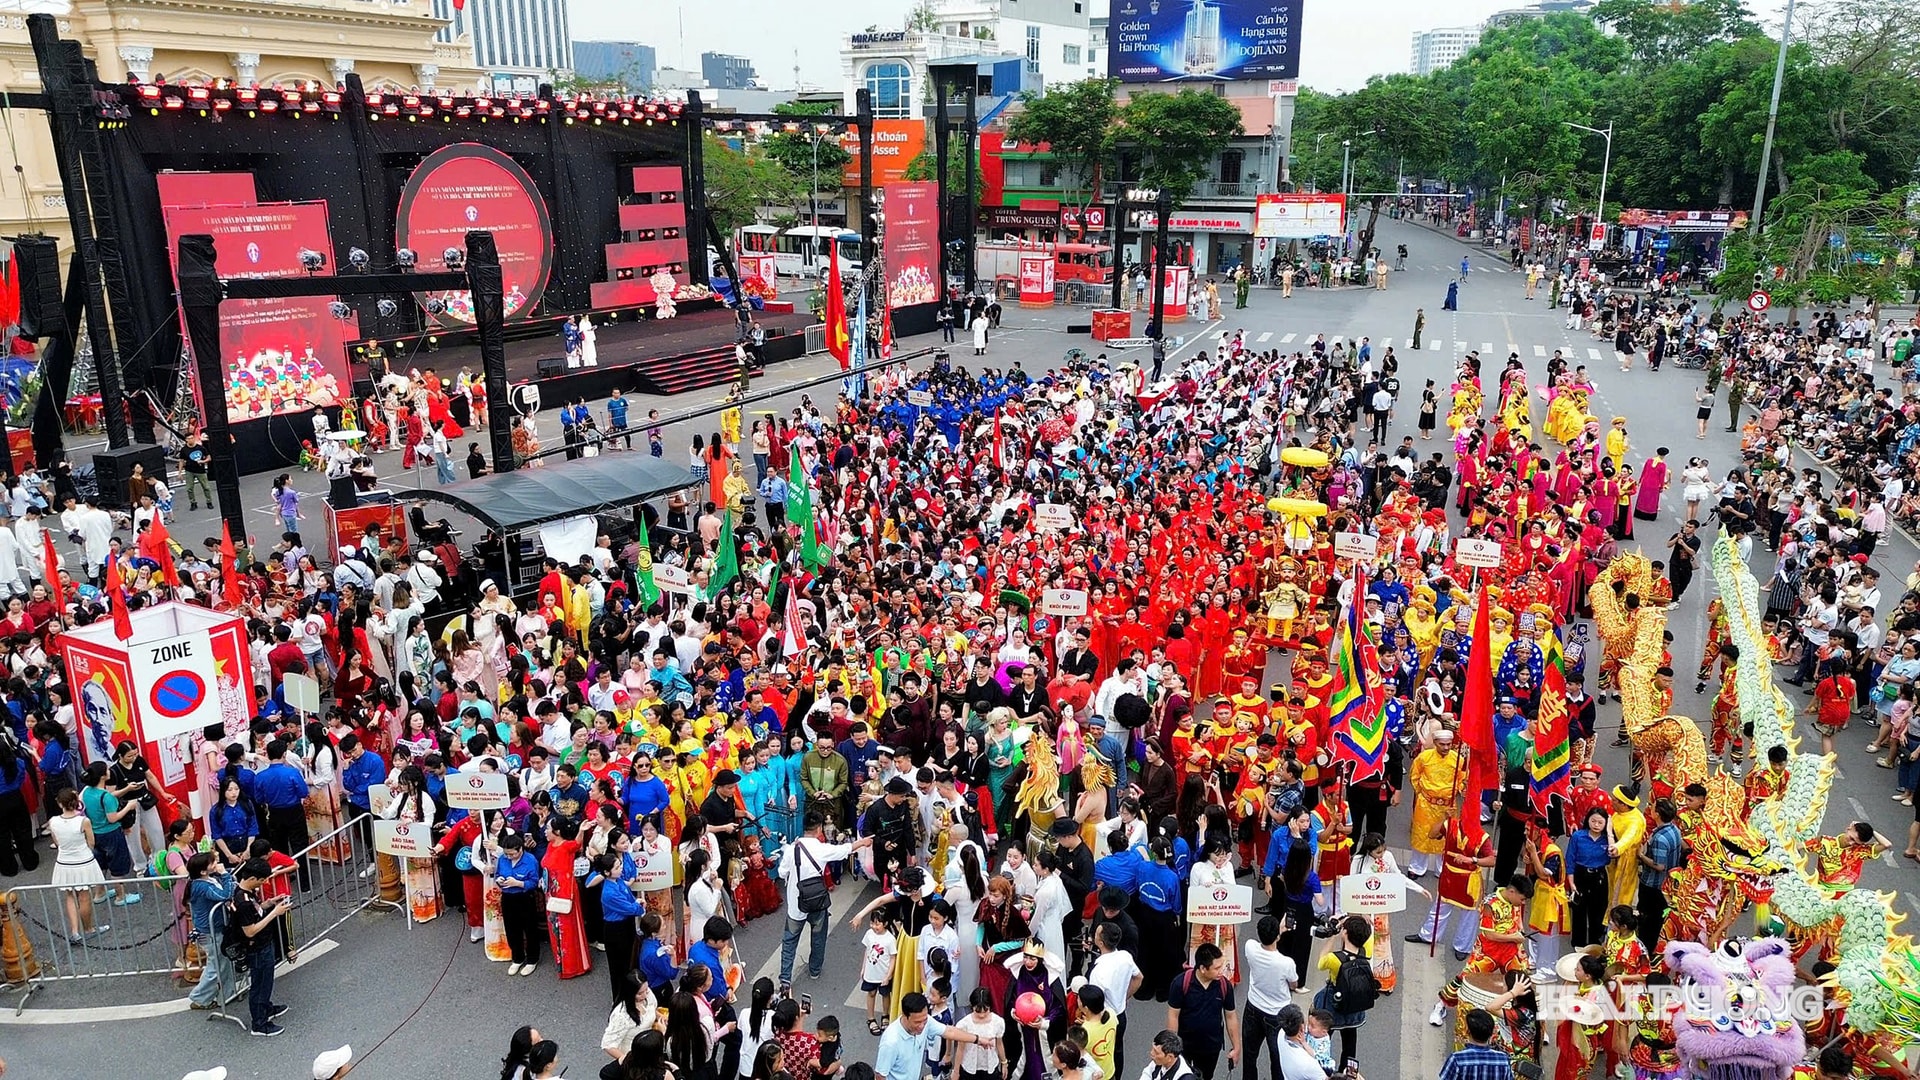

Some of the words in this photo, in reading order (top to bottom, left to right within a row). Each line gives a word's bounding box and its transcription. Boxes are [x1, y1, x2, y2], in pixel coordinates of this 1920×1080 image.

[1256, 15, 1274, 24] Căn
[1276, 14, 1288, 26] hộ
[1120, 21, 1150, 31] Golden
[852, 33, 878, 44] MIRAE
[880, 32, 905, 42] ASSET
[1119, 32, 1147, 42] Crown
[1241, 28, 1265, 38] Hạng
[1266, 27, 1288, 37] sang
[1119, 42, 1132, 52] Hai
[1134, 42, 1160, 53] Phong
[1240, 45, 1286, 58] DOJILAND
[876, 131, 908, 142] Khoán
[872, 145, 899, 155] Asset
[995, 216, 1021, 224] TRUNG
[1024, 216, 1057, 224] NGUYÊN
[1388, 382, 1398, 390] 26
[151, 641, 192, 664] ZONE
[72, 654, 88, 668] 19-5
